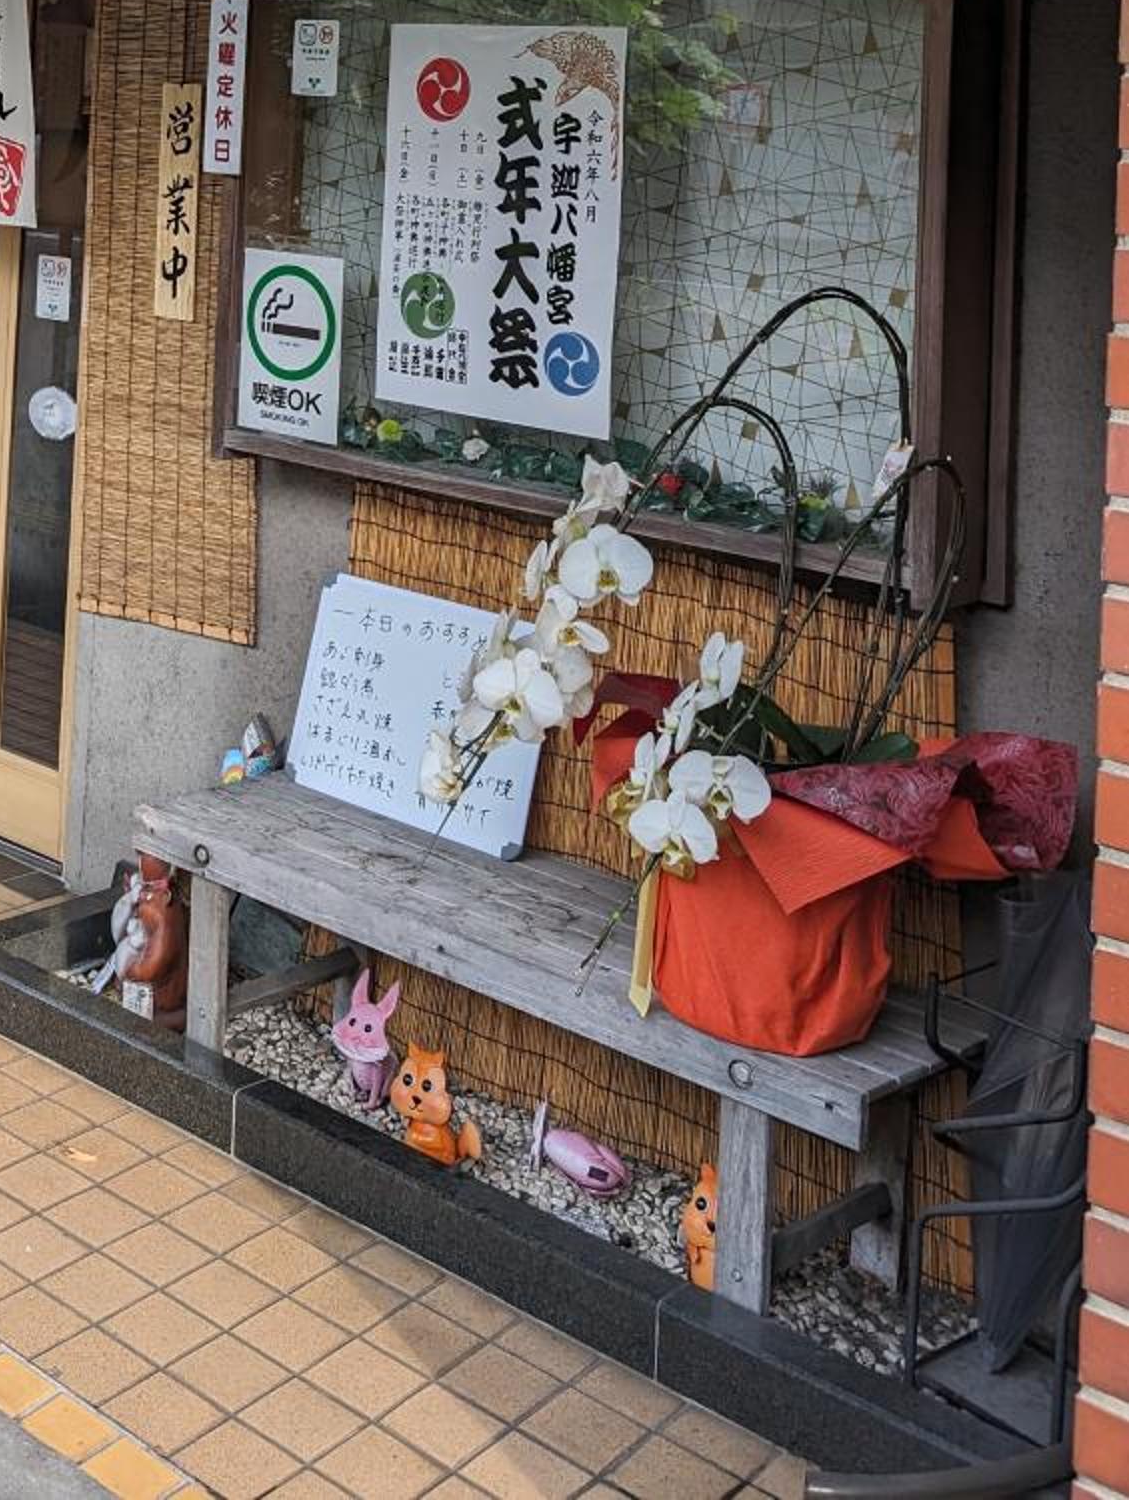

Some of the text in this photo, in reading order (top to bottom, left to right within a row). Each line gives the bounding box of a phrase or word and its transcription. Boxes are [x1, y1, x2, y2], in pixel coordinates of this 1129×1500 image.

[214, 10, 239, 163] 火曜定休日
[583, 109, 605, 224] 令和六年八月
[161, 101, 194, 298] 営業中
[488, 75, 549, 389] 式年大祭
[546, 112, 583, 326] 宇迦八幡宮
[252, 382, 323, 415] 喫煙OK
